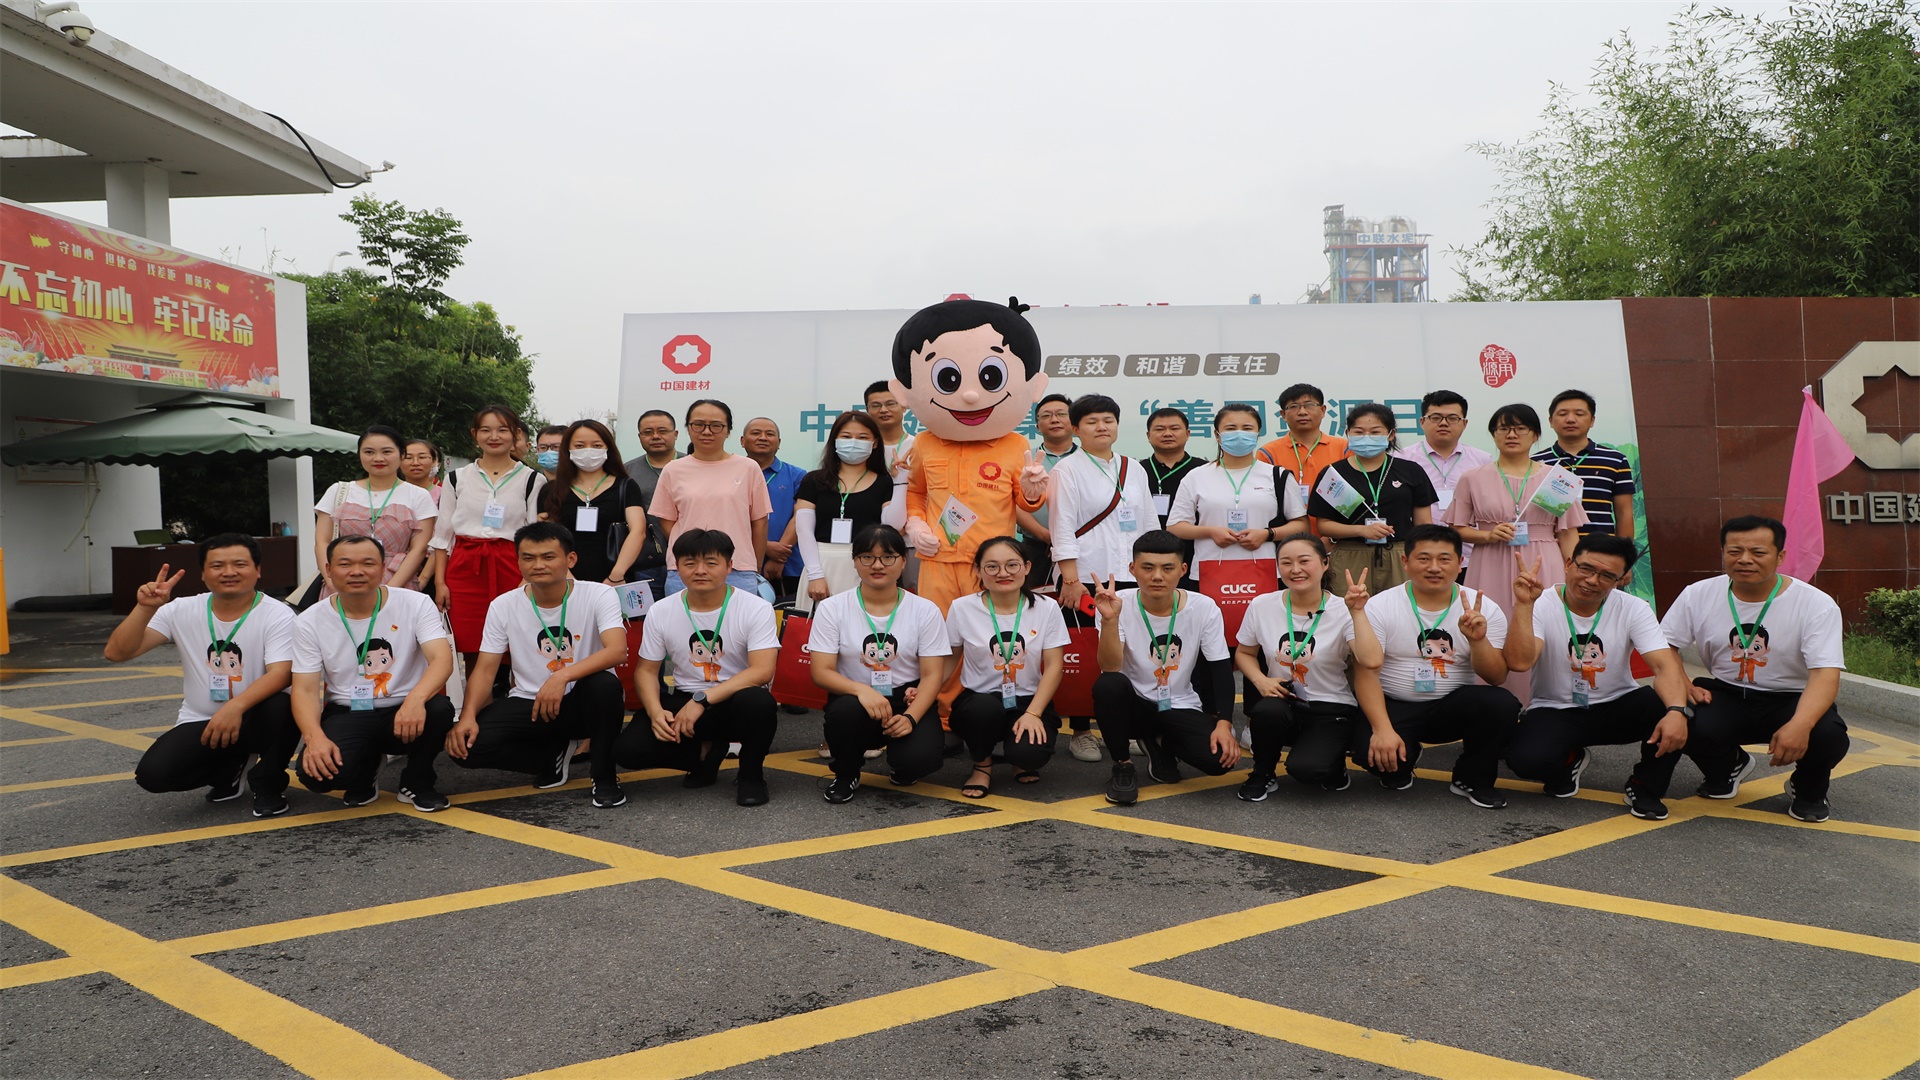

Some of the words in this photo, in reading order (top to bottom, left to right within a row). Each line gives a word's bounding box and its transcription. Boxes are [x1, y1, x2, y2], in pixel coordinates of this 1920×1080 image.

[1358, 233, 1413, 243] 中联水泥
[58, 241, 94, 261] 守初心
[105, 252, 137, 271] 担使命
[147, 263, 176, 282] 找差距
[0, 260, 134, 324] 不忘初心
[153, 296, 254, 347] 牢记使命
[1058, 357, 1109, 376] 绩效
[1136, 356, 1187, 375] 和谐
[1217, 355, 1268, 374] 责任
[660, 380, 711, 391] 中国建材
[1220, 584, 1257, 594] CUCC
